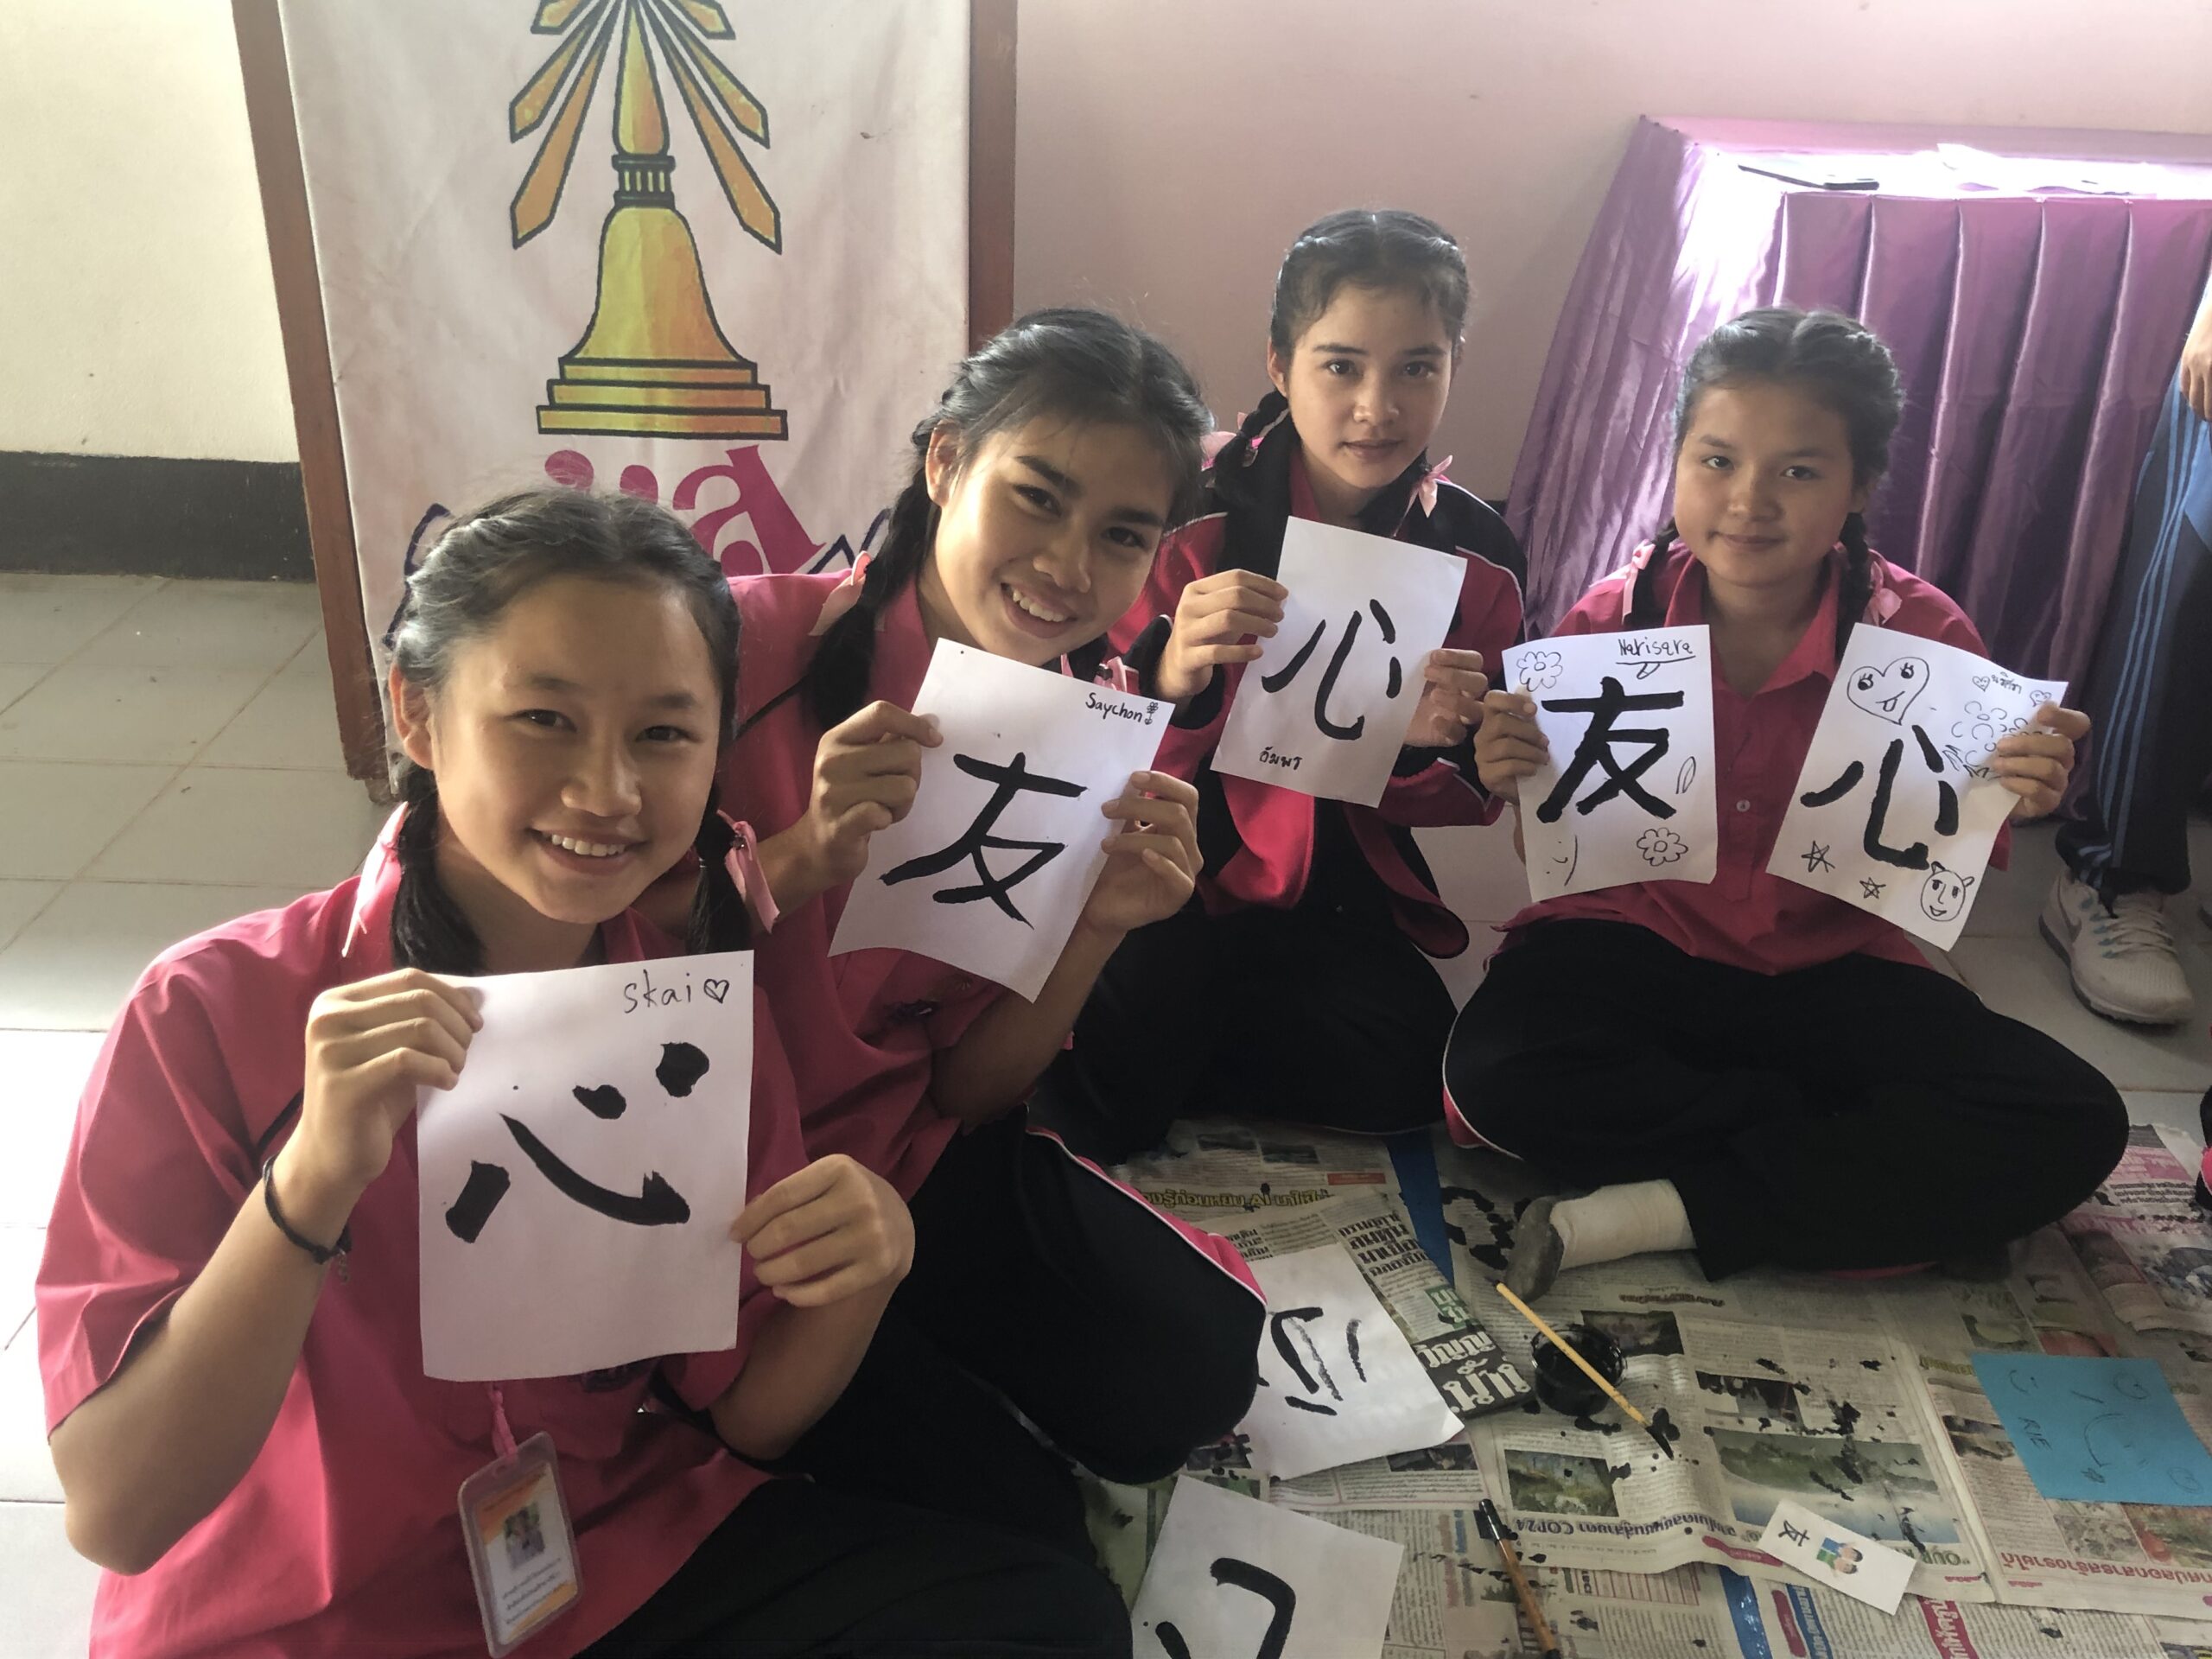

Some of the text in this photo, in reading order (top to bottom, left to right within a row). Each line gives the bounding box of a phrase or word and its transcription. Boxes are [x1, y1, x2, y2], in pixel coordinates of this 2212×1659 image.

[1085, 692, 1143, 722] Saychon
[1261, 598, 1402, 741] 心
[1536, 676, 1684, 823] 友
[1800, 724, 1959, 870] 心
[877, 752, 1089, 931] 友
[445, 1041, 710, 1244] 心
[1249, 1192, 1272, 1207] AI
[1515, 1517, 1575, 1536] COP24
